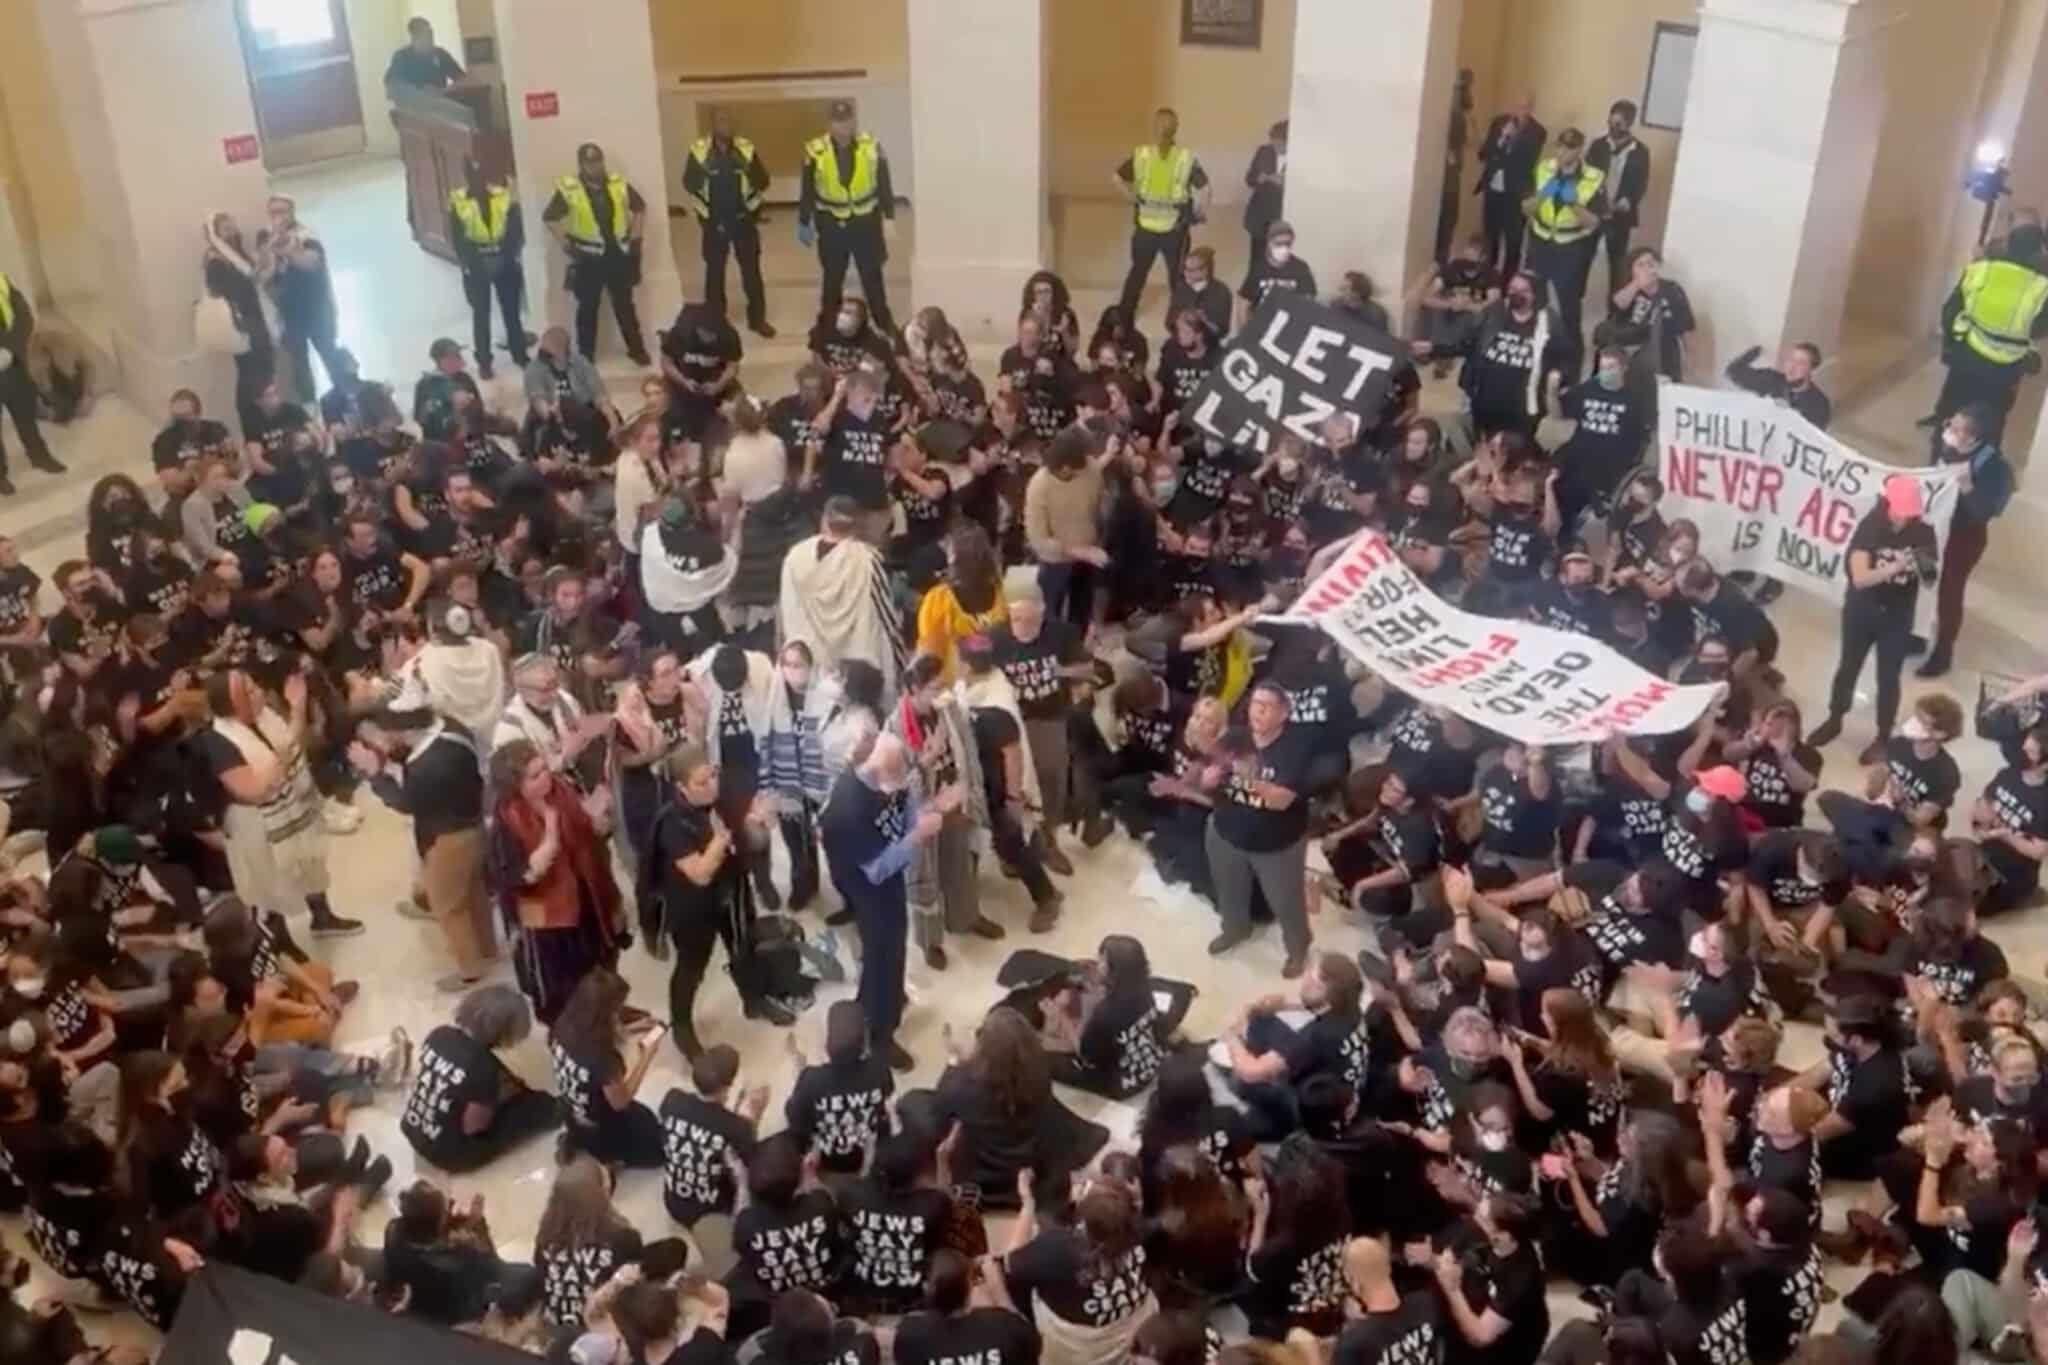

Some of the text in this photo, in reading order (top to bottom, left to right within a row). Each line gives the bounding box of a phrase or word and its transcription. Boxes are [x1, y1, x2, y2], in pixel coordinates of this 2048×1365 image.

[1259, 309, 1393, 401] LET
[1675, 406, 1777, 453] PHILLY
[1782, 431, 1869, 496] JEWS
[1668, 444, 1785, 515] NEVER
[1731, 520, 1764, 553] IS
[1776, 526, 1842, 580] NOW
[1360, 569, 1421, 611] FOR
[1290, 708, 1329, 723] AME
[1536, 687, 1612, 729] THE
[815, 1088, 883, 1111] JEWS
[750, 1215, 827, 1251] JEWS
[852, 1208, 925, 1234] JEWS
[762, 1237, 820, 1268] SAY
[860, 1229, 917, 1250] SAY
[548, 1262, 601, 1284] SAY
[1091, 1265, 1142, 1299] SAY
